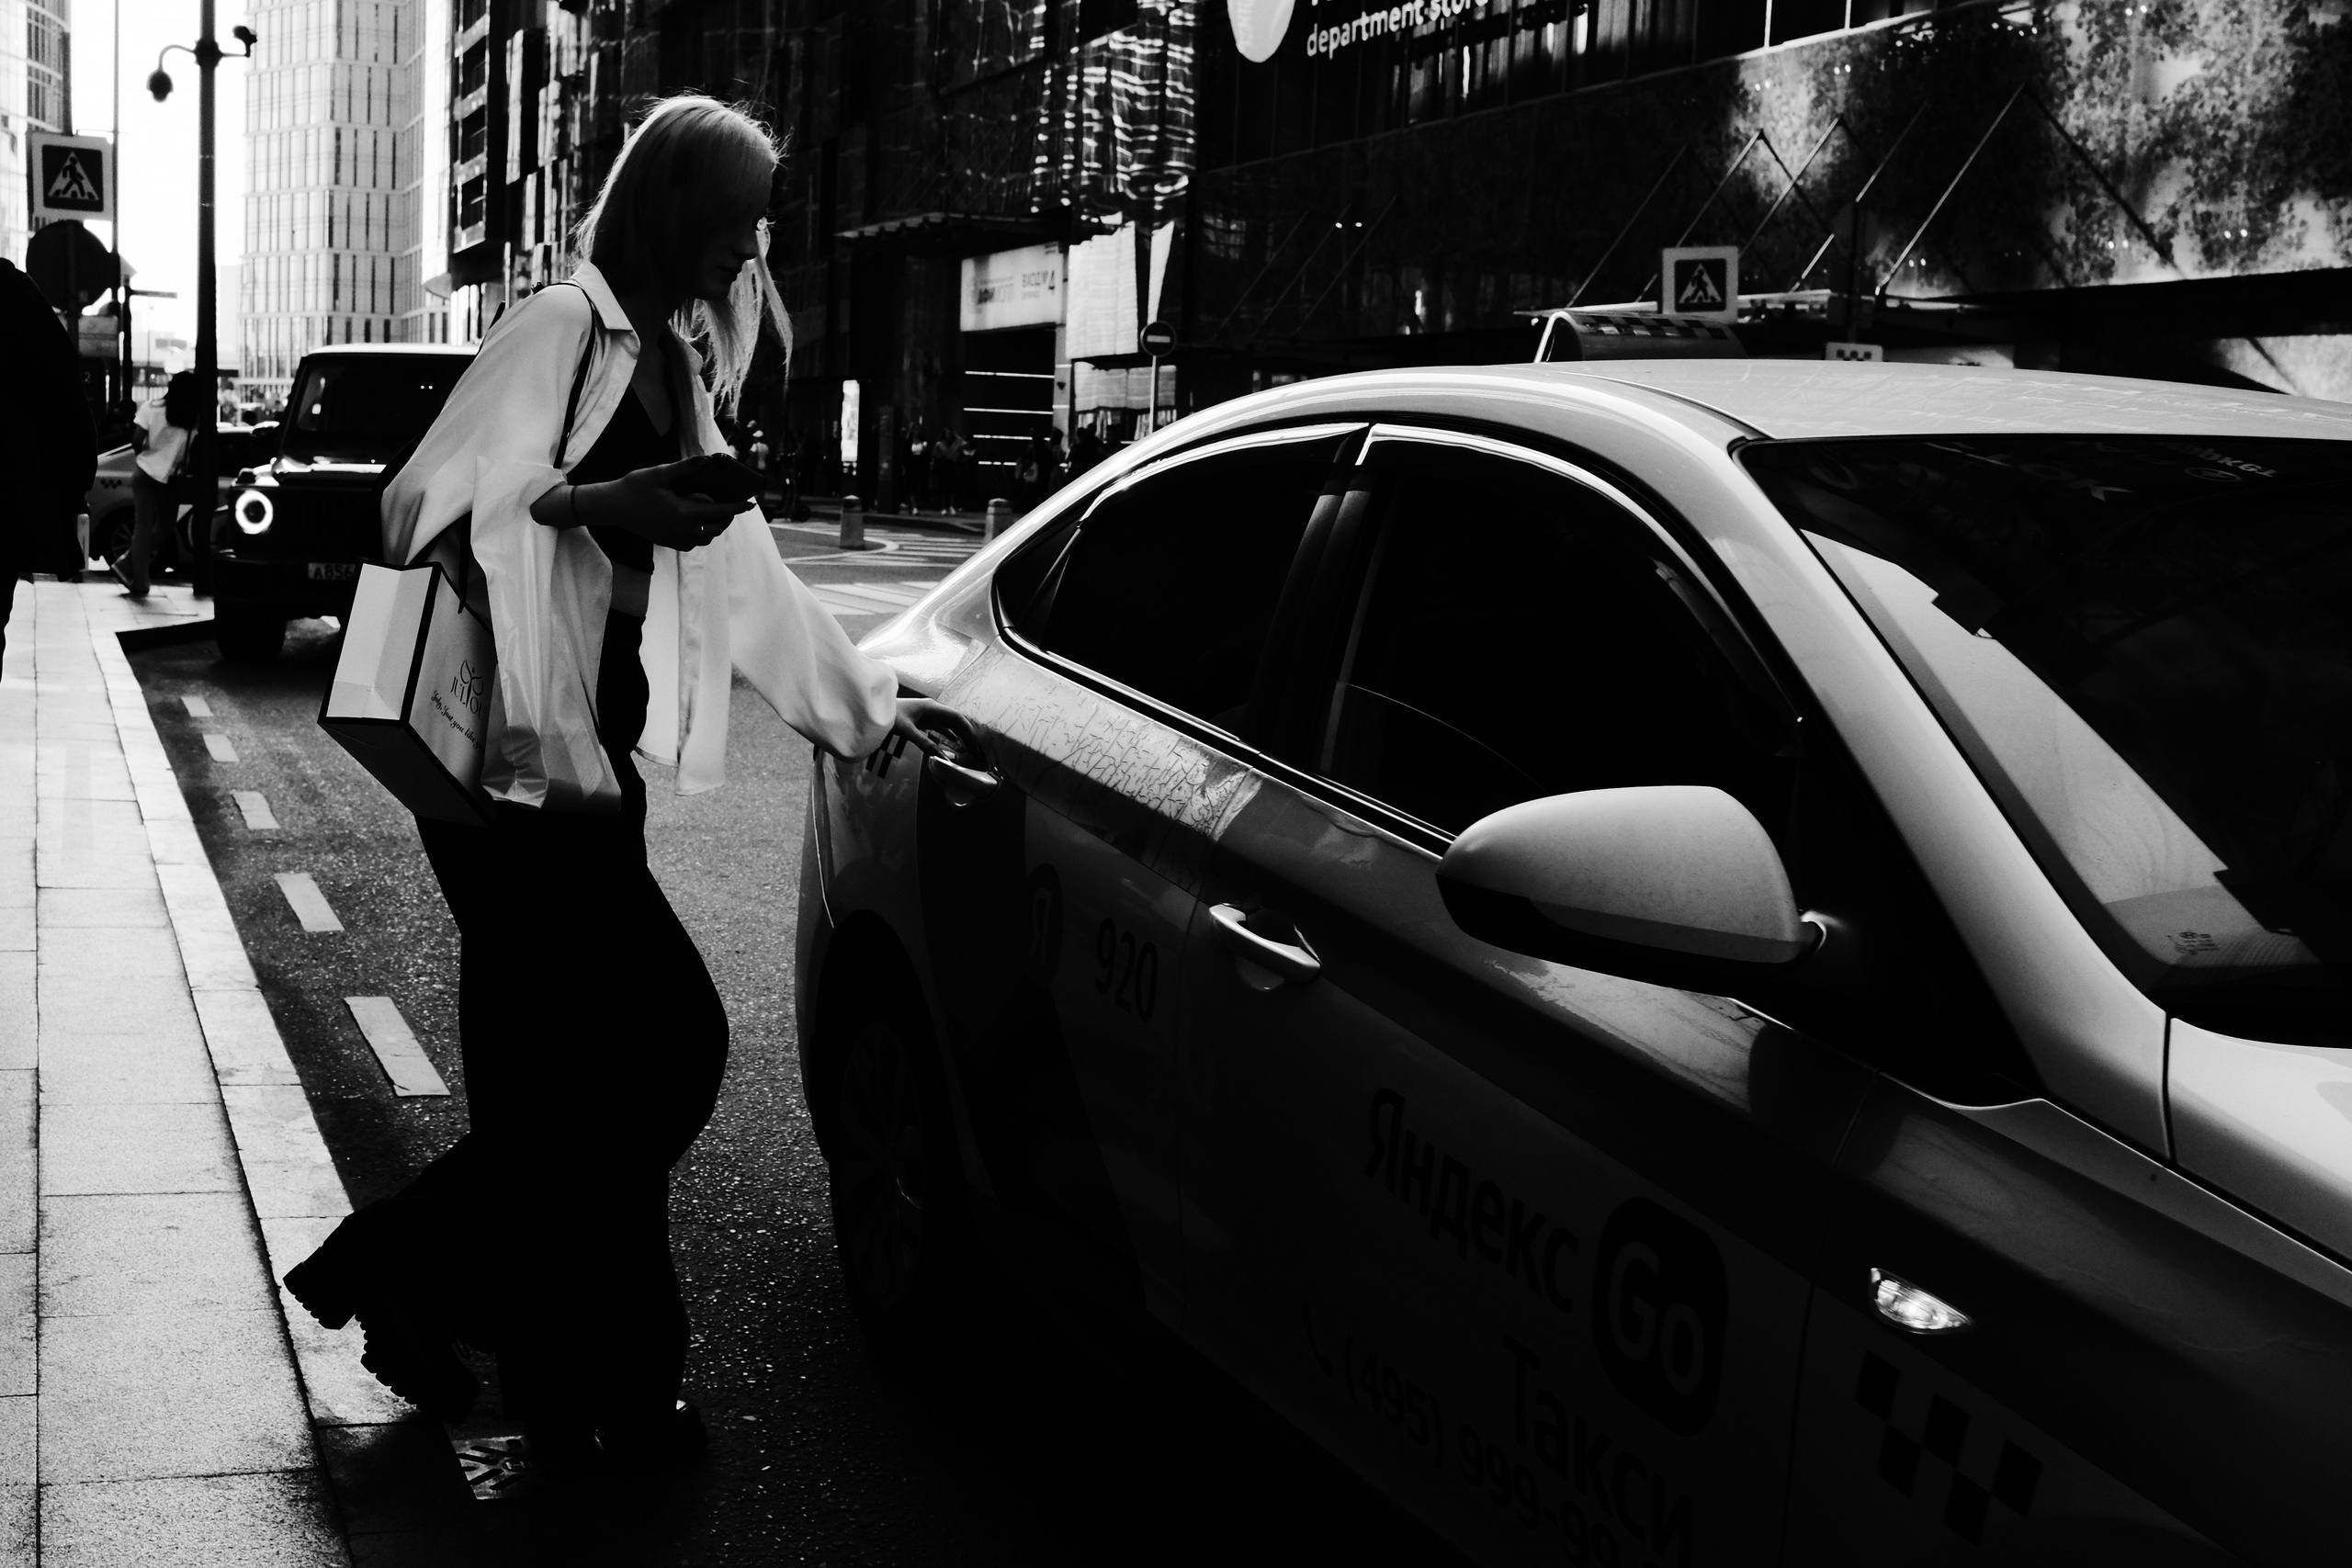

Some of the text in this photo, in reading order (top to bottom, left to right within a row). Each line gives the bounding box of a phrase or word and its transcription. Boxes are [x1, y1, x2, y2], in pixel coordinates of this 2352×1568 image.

[1306, 1, 1424, 60] department
[450, 720, 464, 733] you
[1095, 917, 1158, 1023] 920
[1363, 1088, 1705, 1395] Яндекс Go
[1344, 1335, 1444, 1470] (495)
[1502, 1332, 1692, 1568] Такси
